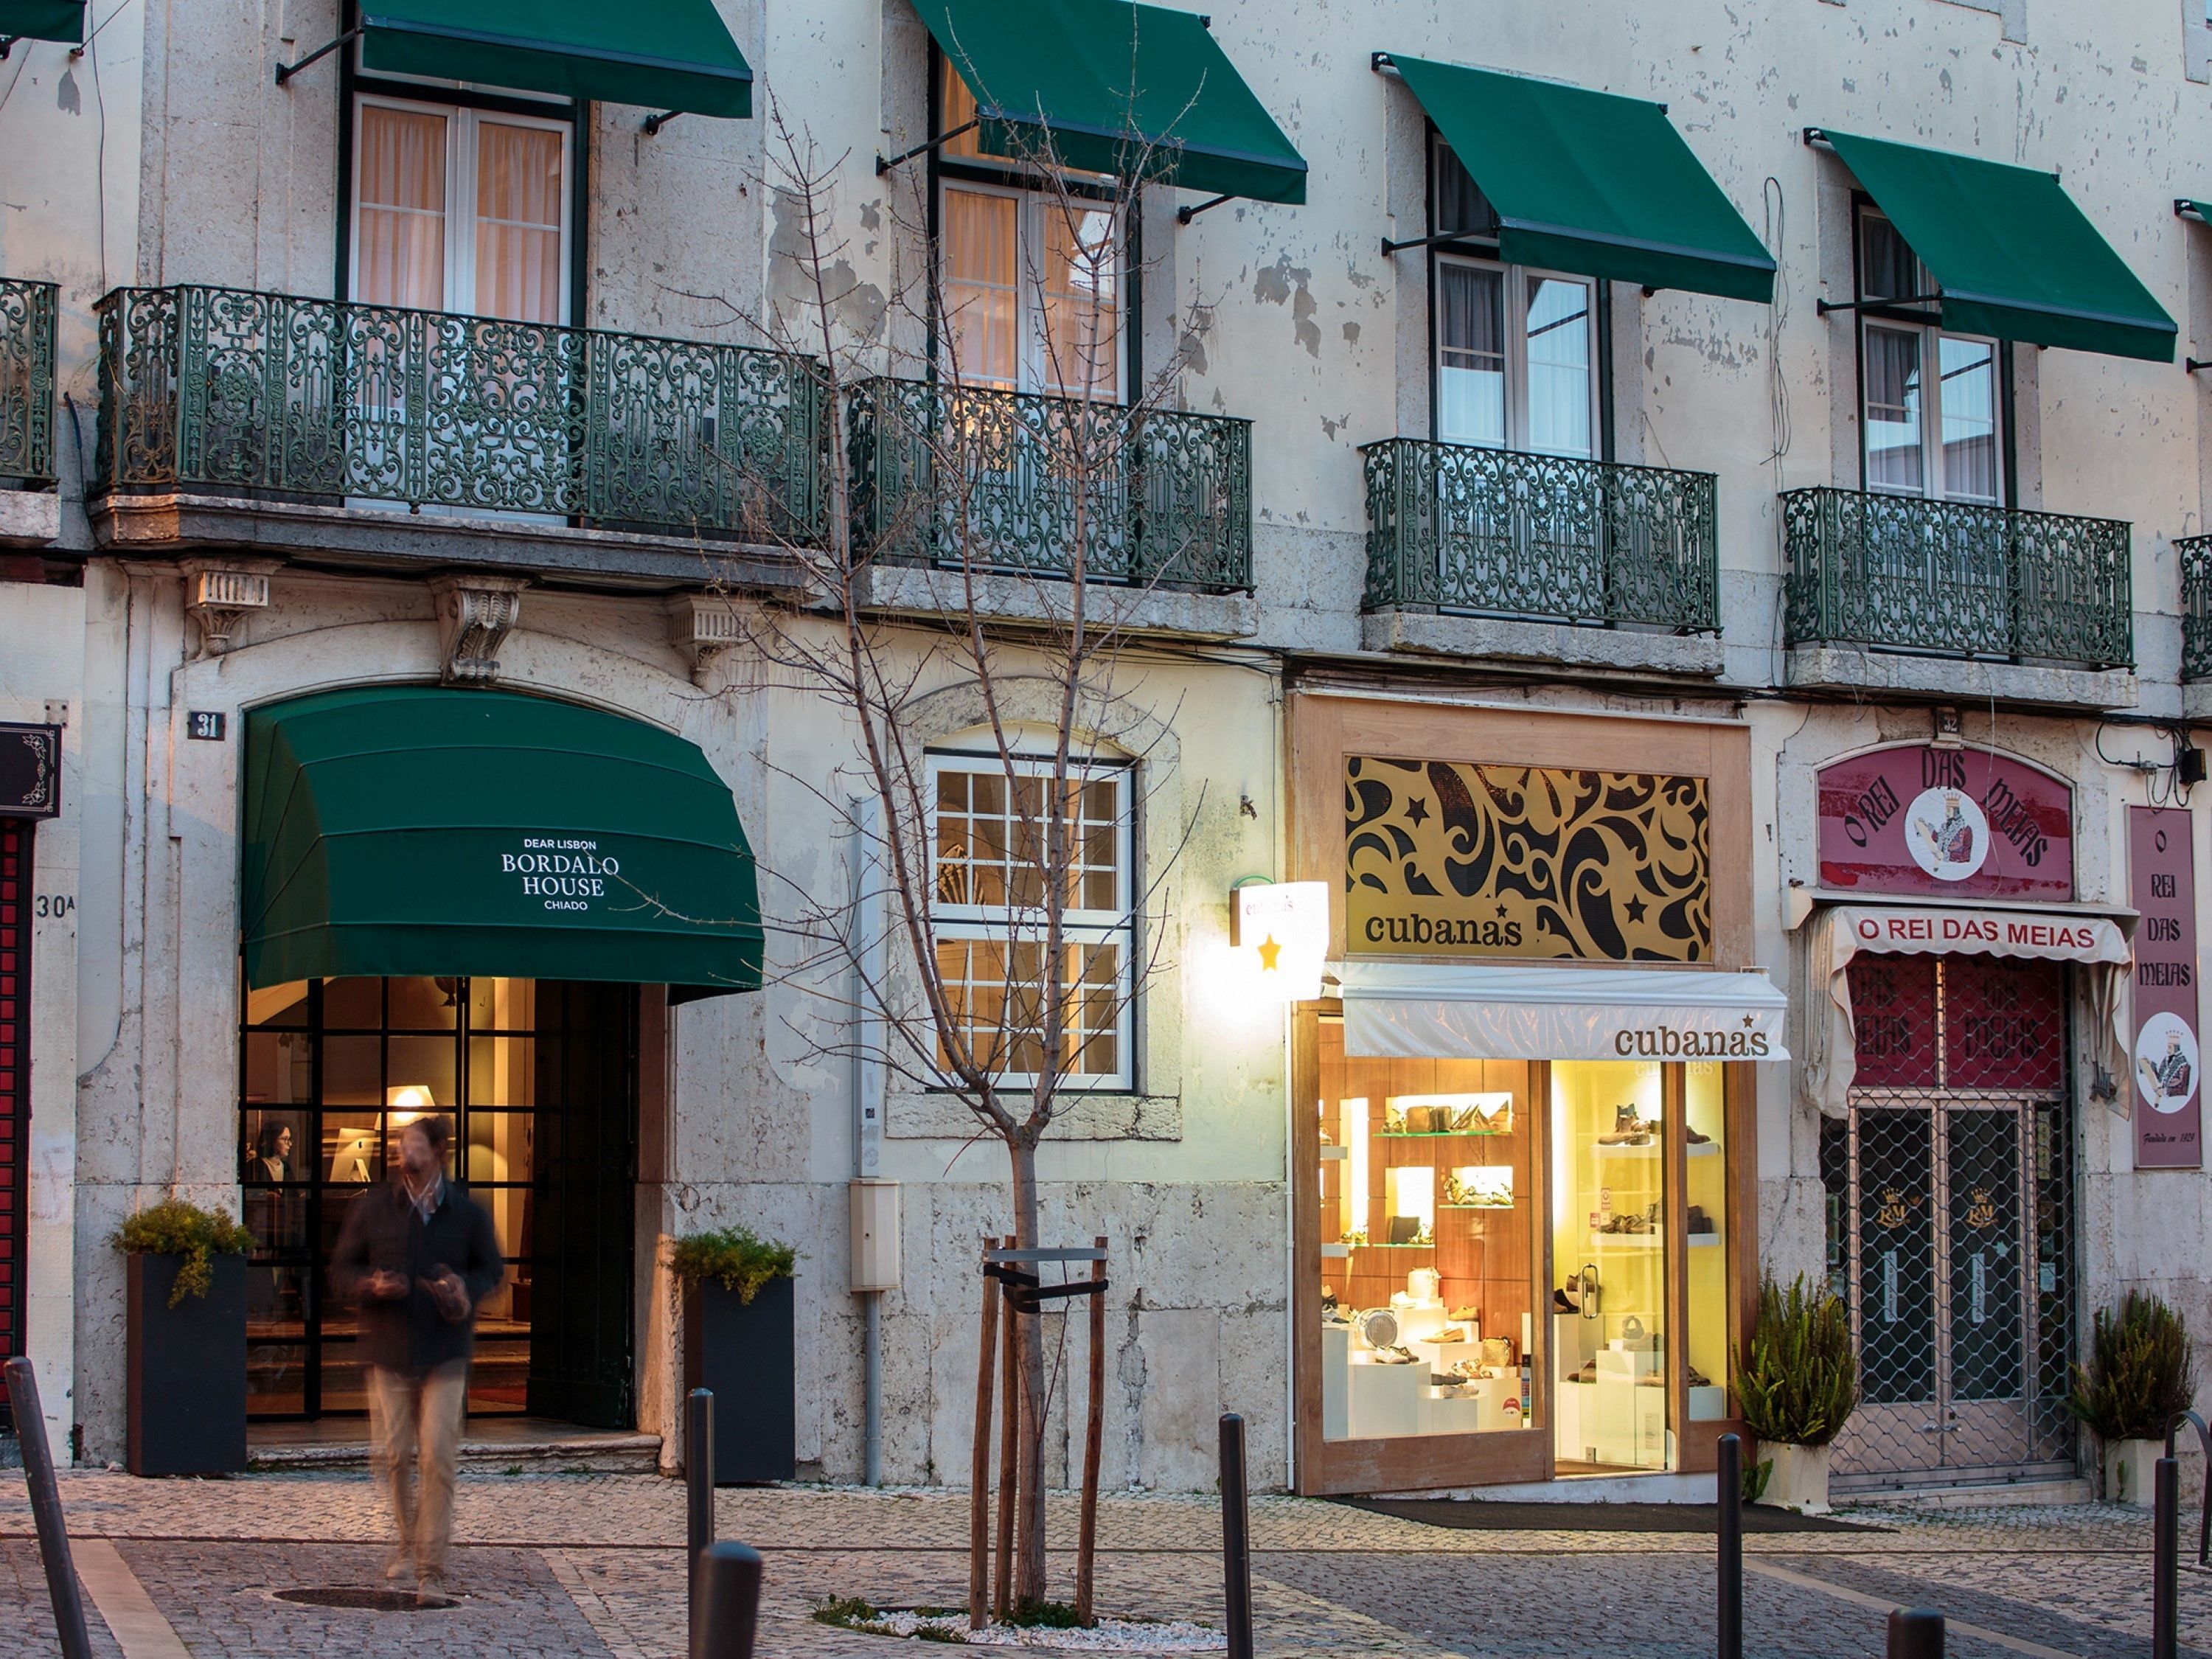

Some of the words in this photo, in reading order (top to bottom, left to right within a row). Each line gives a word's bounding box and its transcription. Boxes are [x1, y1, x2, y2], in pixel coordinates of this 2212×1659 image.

[197, 714, 218, 737] 31
[1845, 815, 1867, 847] O
[1857, 775, 1900, 832] REI
[1921, 748, 1966, 790] DAS
[1983, 778, 2048, 866] MEIAS
[524, 838, 554, 848] DEAR
[557, 840, 597, 849] LISBON
[2154, 830, 2167, 853] O
[501, 853, 619, 875] BORDALO
[522, 877, 605, 897] HOUSE
[2151, 873, 2176, 898] REI
[544, 900, 588, 911] CHIADO
[1366, 913, 1523, 947] cubanas
[1859, 918, 1880, 940] O
[1888, 919, 1933, 940] REI
[1942, 919, 1998, 942] DAS
[2007, 923, 2096, 949] MEIAS
[2147, 917, 2181, 942] DAS
[2139, 962, 2191, 987] MEIAS
[1615, 1025, 1770, 1057] cubanas
